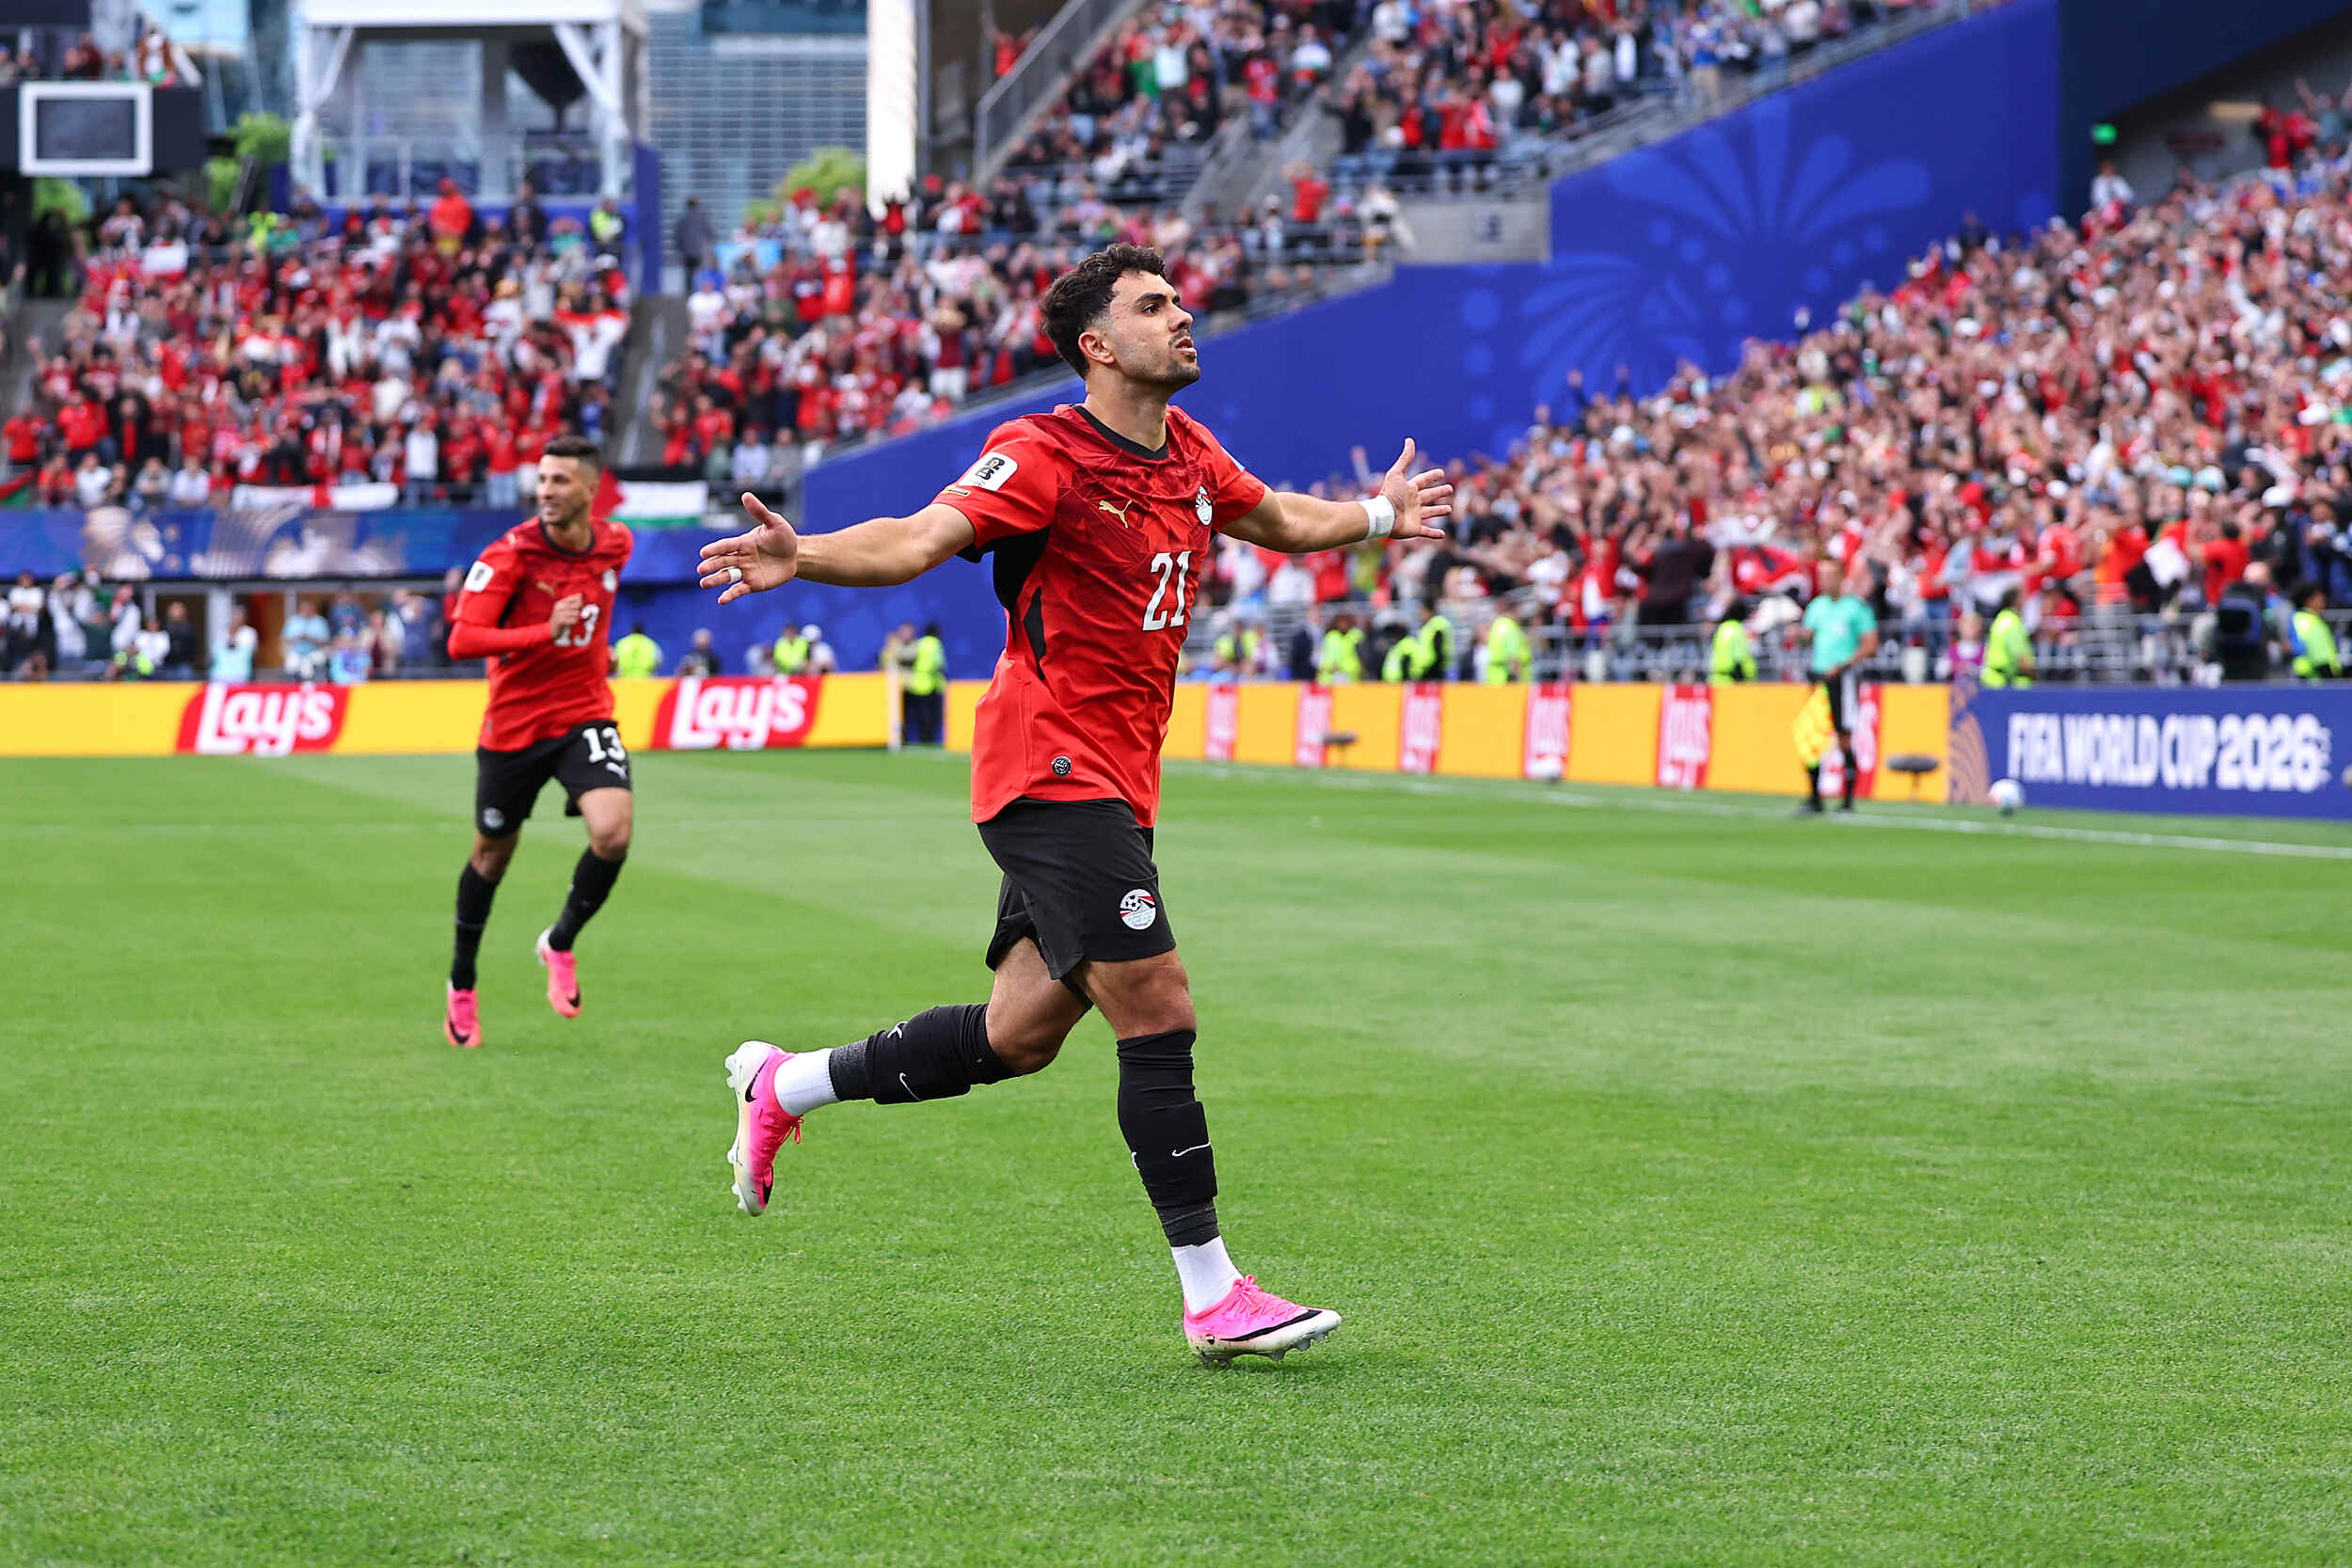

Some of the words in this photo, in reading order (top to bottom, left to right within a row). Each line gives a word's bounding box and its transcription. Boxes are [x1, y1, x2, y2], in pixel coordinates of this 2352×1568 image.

[1143, 550, 1192, 631] 21
[195, 682, 335, 757] Lay's
[582, 727, 626, 763] 13
[670, 674, 808, 751] Lay's
[2008, 712, 2064, 784] FIFA
[2063, 713, 2160, 787] WORLD
[2161, 714, 2217, 790] CUP
[2216, 713, 2321, 794] 2026
